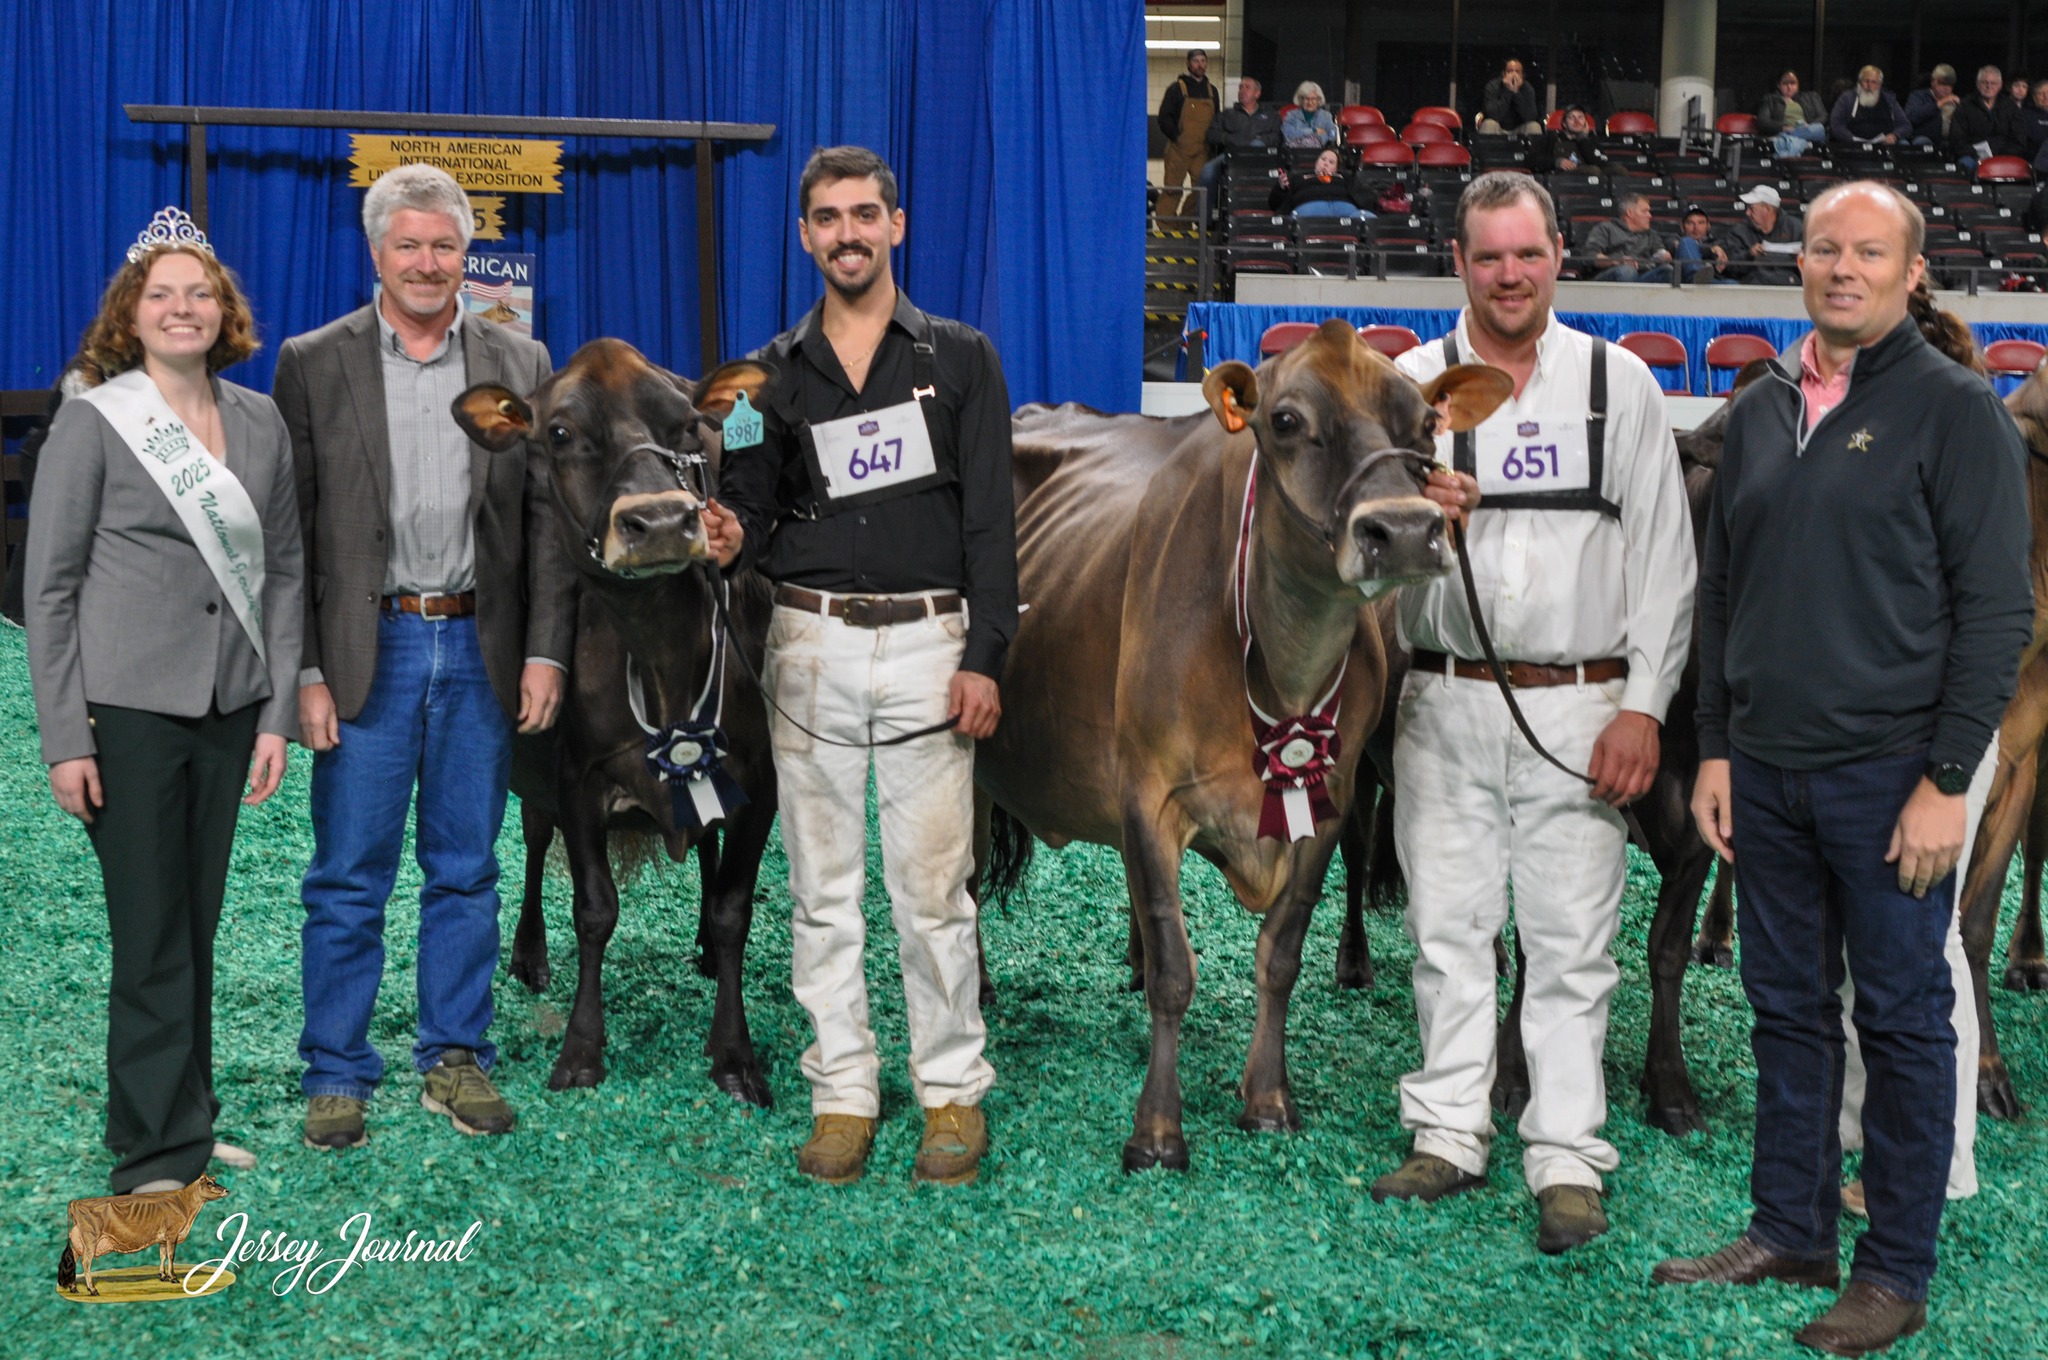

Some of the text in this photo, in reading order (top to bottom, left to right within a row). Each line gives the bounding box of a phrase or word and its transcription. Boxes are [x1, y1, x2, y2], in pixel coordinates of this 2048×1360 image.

[390, 140, 522, 156] NORTH AMERICAN
[400, 155, 512, 171] INTERNATIONAL
[456, 172, 543, 187] EXPOSITION
[726, 421, 761, 447] 5987
[849, 438, 903, 480] 647
[1502, 444, 1559, 481] 651
[171, 457, 210, 497] 2025
[198, 490, 239, 562] National
